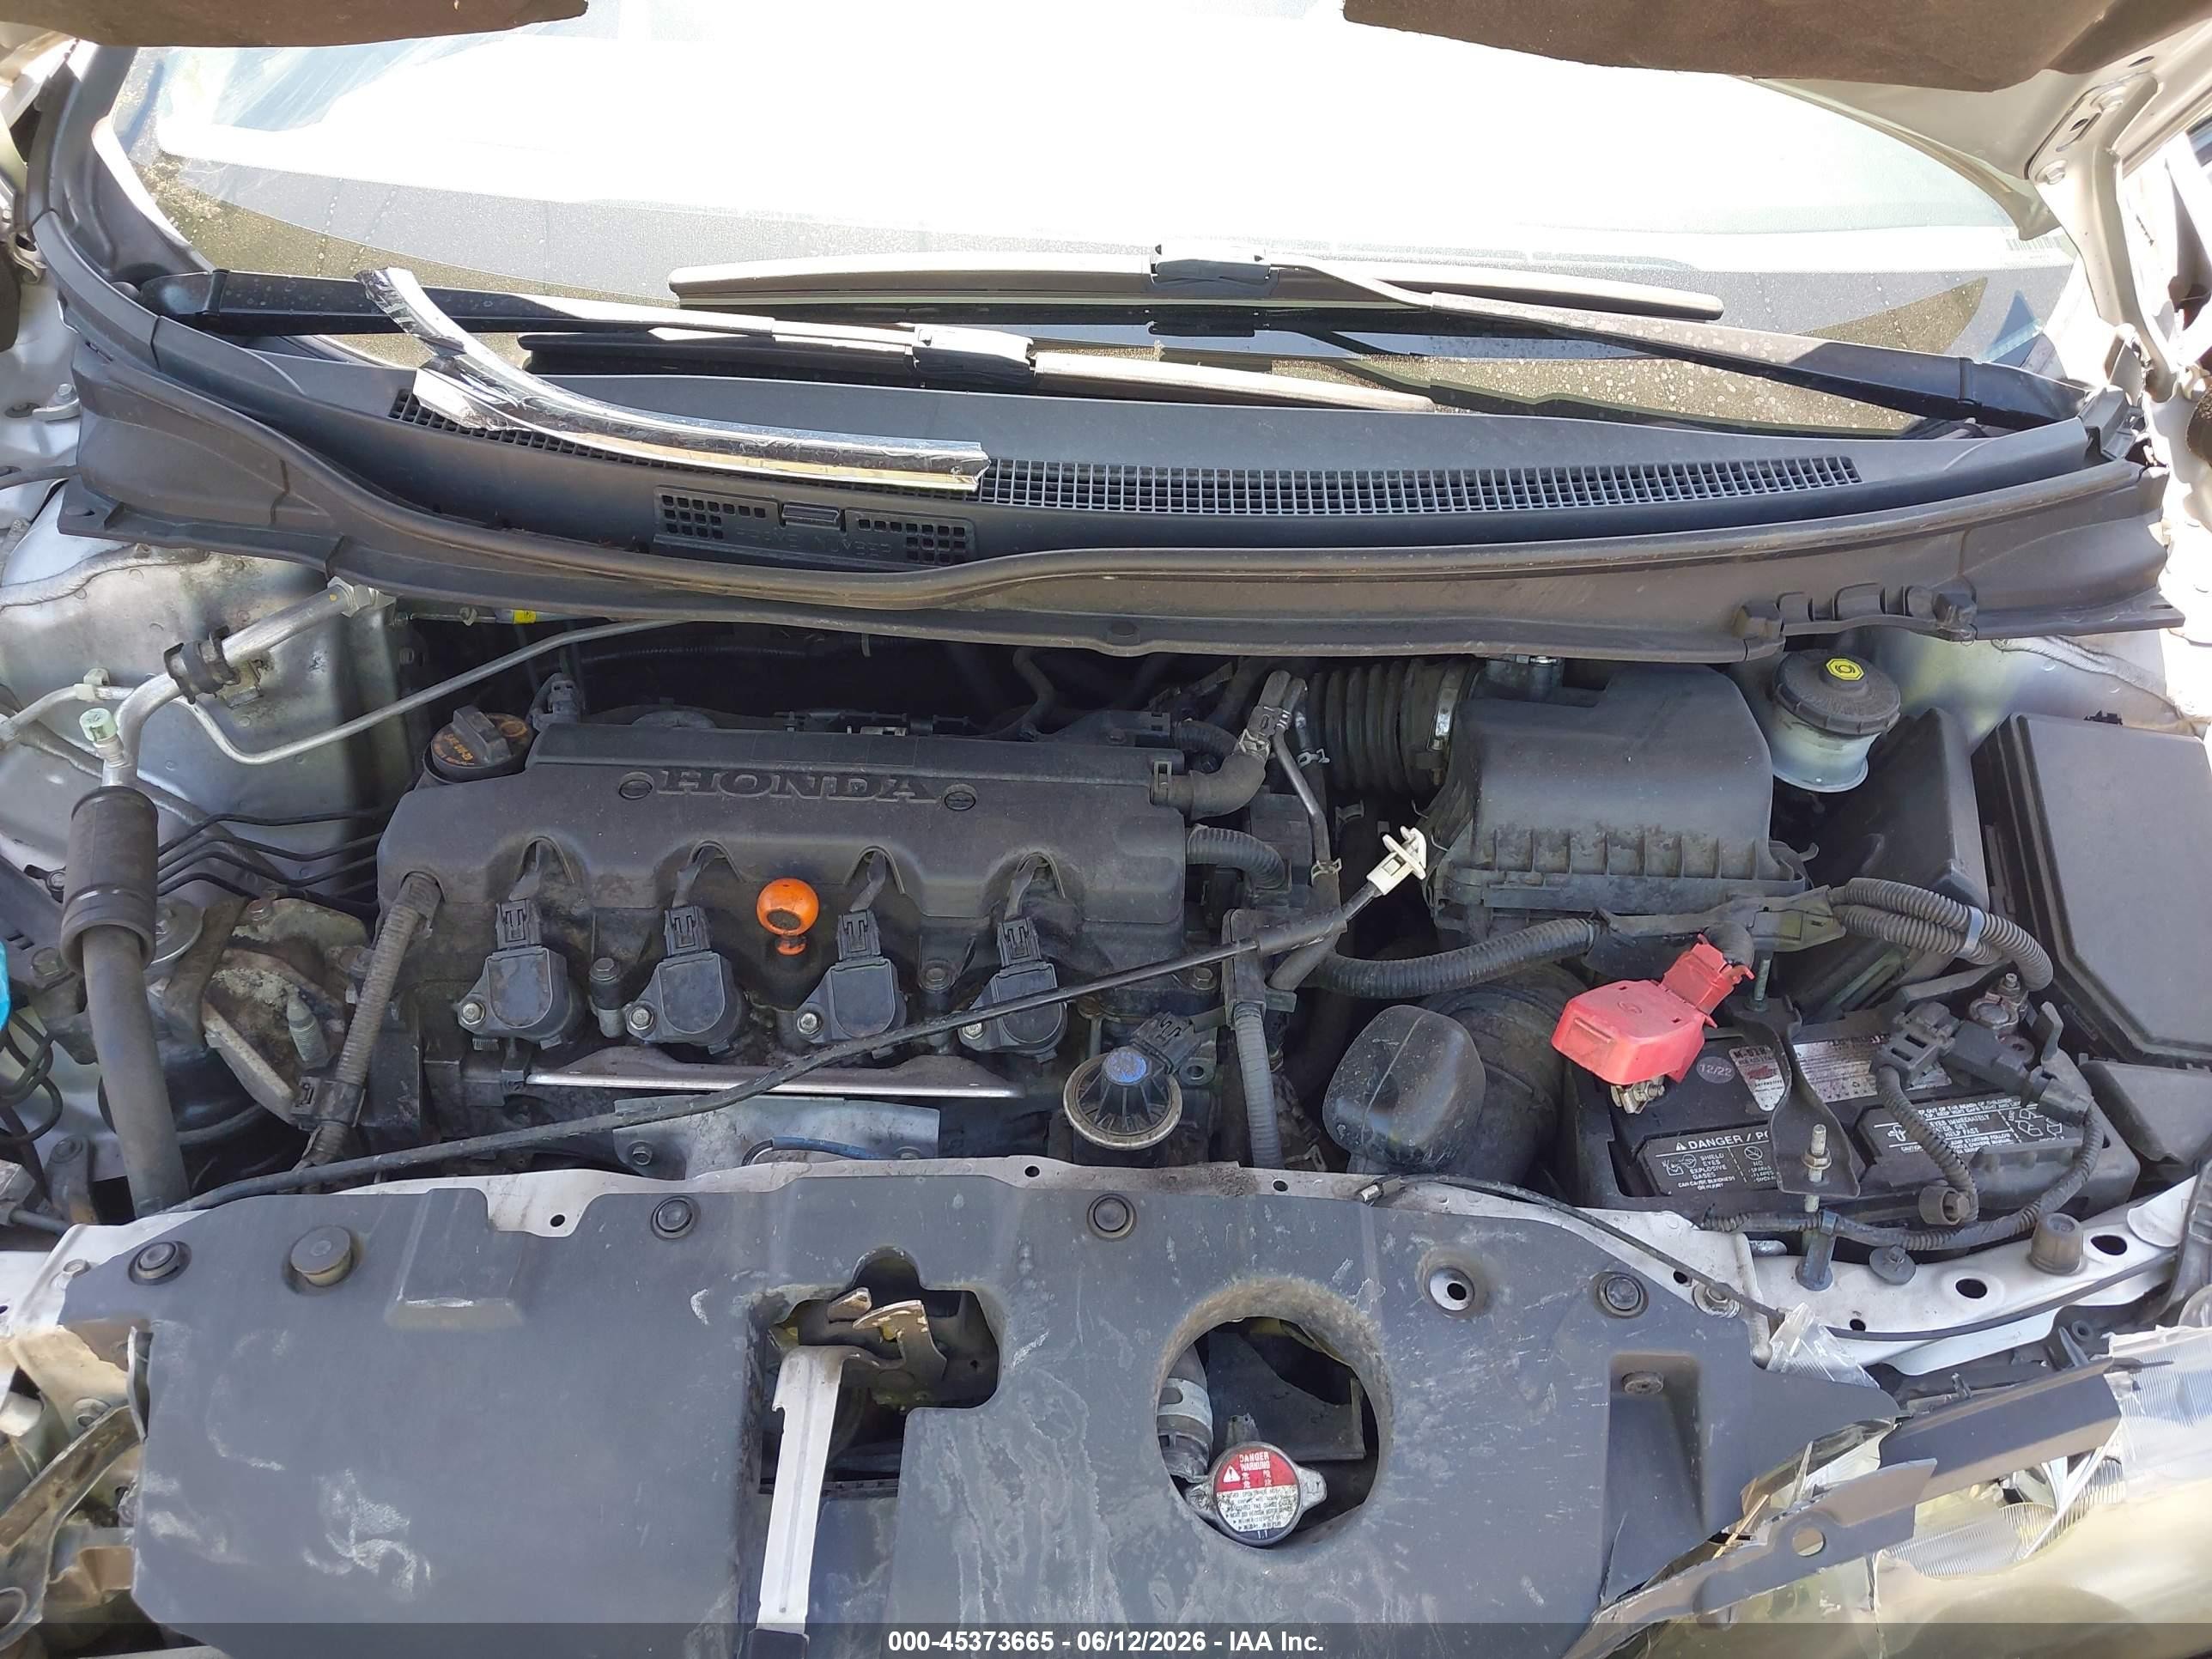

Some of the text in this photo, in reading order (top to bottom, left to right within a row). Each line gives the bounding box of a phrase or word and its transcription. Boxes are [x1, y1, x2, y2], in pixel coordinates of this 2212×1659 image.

[656, 770, 941, 804] HONDA
[1699, 1063, 1733, 1077] 12/22
[1688, 1134, 1743, 1150] DANGER
[1699, 1153, 1725, 1162] SHIELD
[1689, 1164, 1728, 1175] EXPLOSIVE
[1692, 1171, 1717, 1180] GASES
[1239, 1451, 1270, 1462] DANGER
